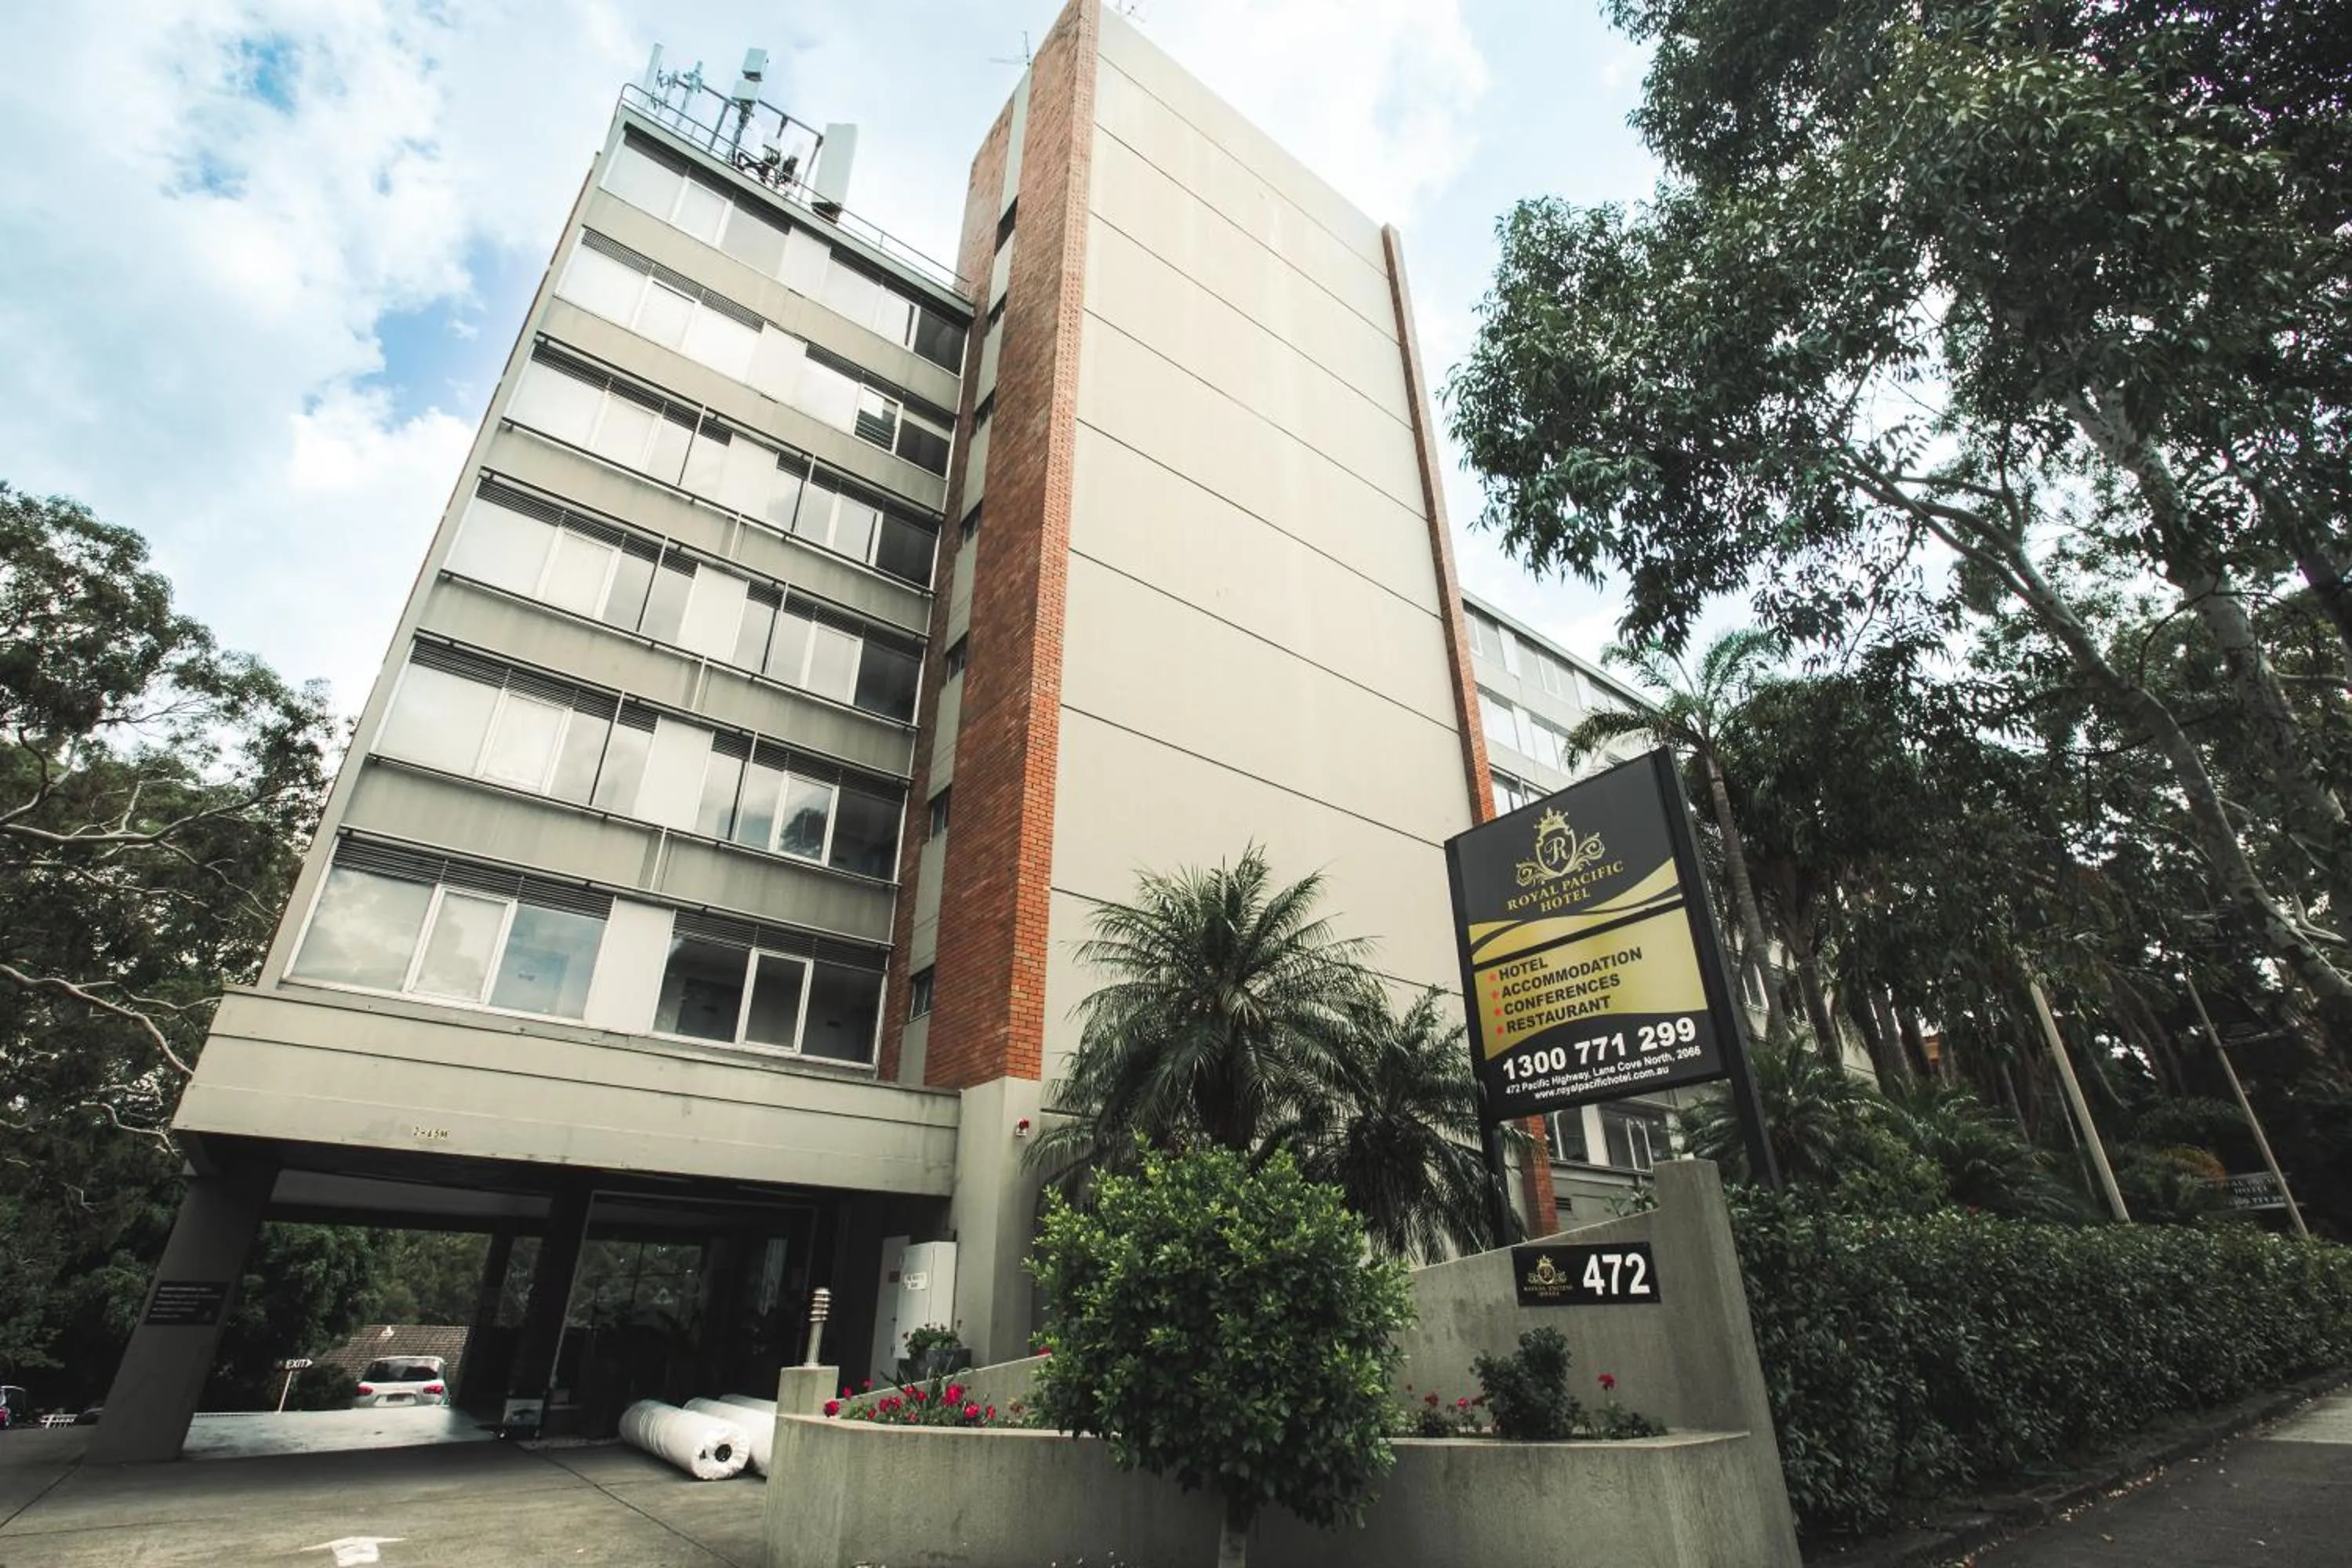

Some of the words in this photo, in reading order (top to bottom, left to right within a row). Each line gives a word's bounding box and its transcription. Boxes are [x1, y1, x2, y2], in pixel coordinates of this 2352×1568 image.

[1507, 885, 1559, 910] ROYAL
[1562, 860, 1624, 891] PACIFIC
[1541, 888, 1591, 912] HOTEL
[1498, 956, 1548, 982] HOTEL
[1501, 946, 1642, 998] ACCOMMODATION
[1504, 973, 1621, 1016] CONFERENCES
[1506, 995, 1611, 1034] RESTAURANT
[1503, 1047, 1566, 1080] 1300
[1574, 1032, 1626, 1065] 771
[1638, 1017, 1696, 1052] 299
[1506, 1083, 1520, 1094] 472
[1522, 1078, 1550, 1092] Pacific
[1592, 1065, 1616, 1077] Lane
[1617, 1059, 1642, 1072] Cove
[1643, 1051, 1675, 1065] North,
[1534, 1066, 1670, 1100] www.royalpacifichotel.com.au
[1583, 1252, 1650, 1295] 472
[285, 1359, 308, 1370] EXIT
